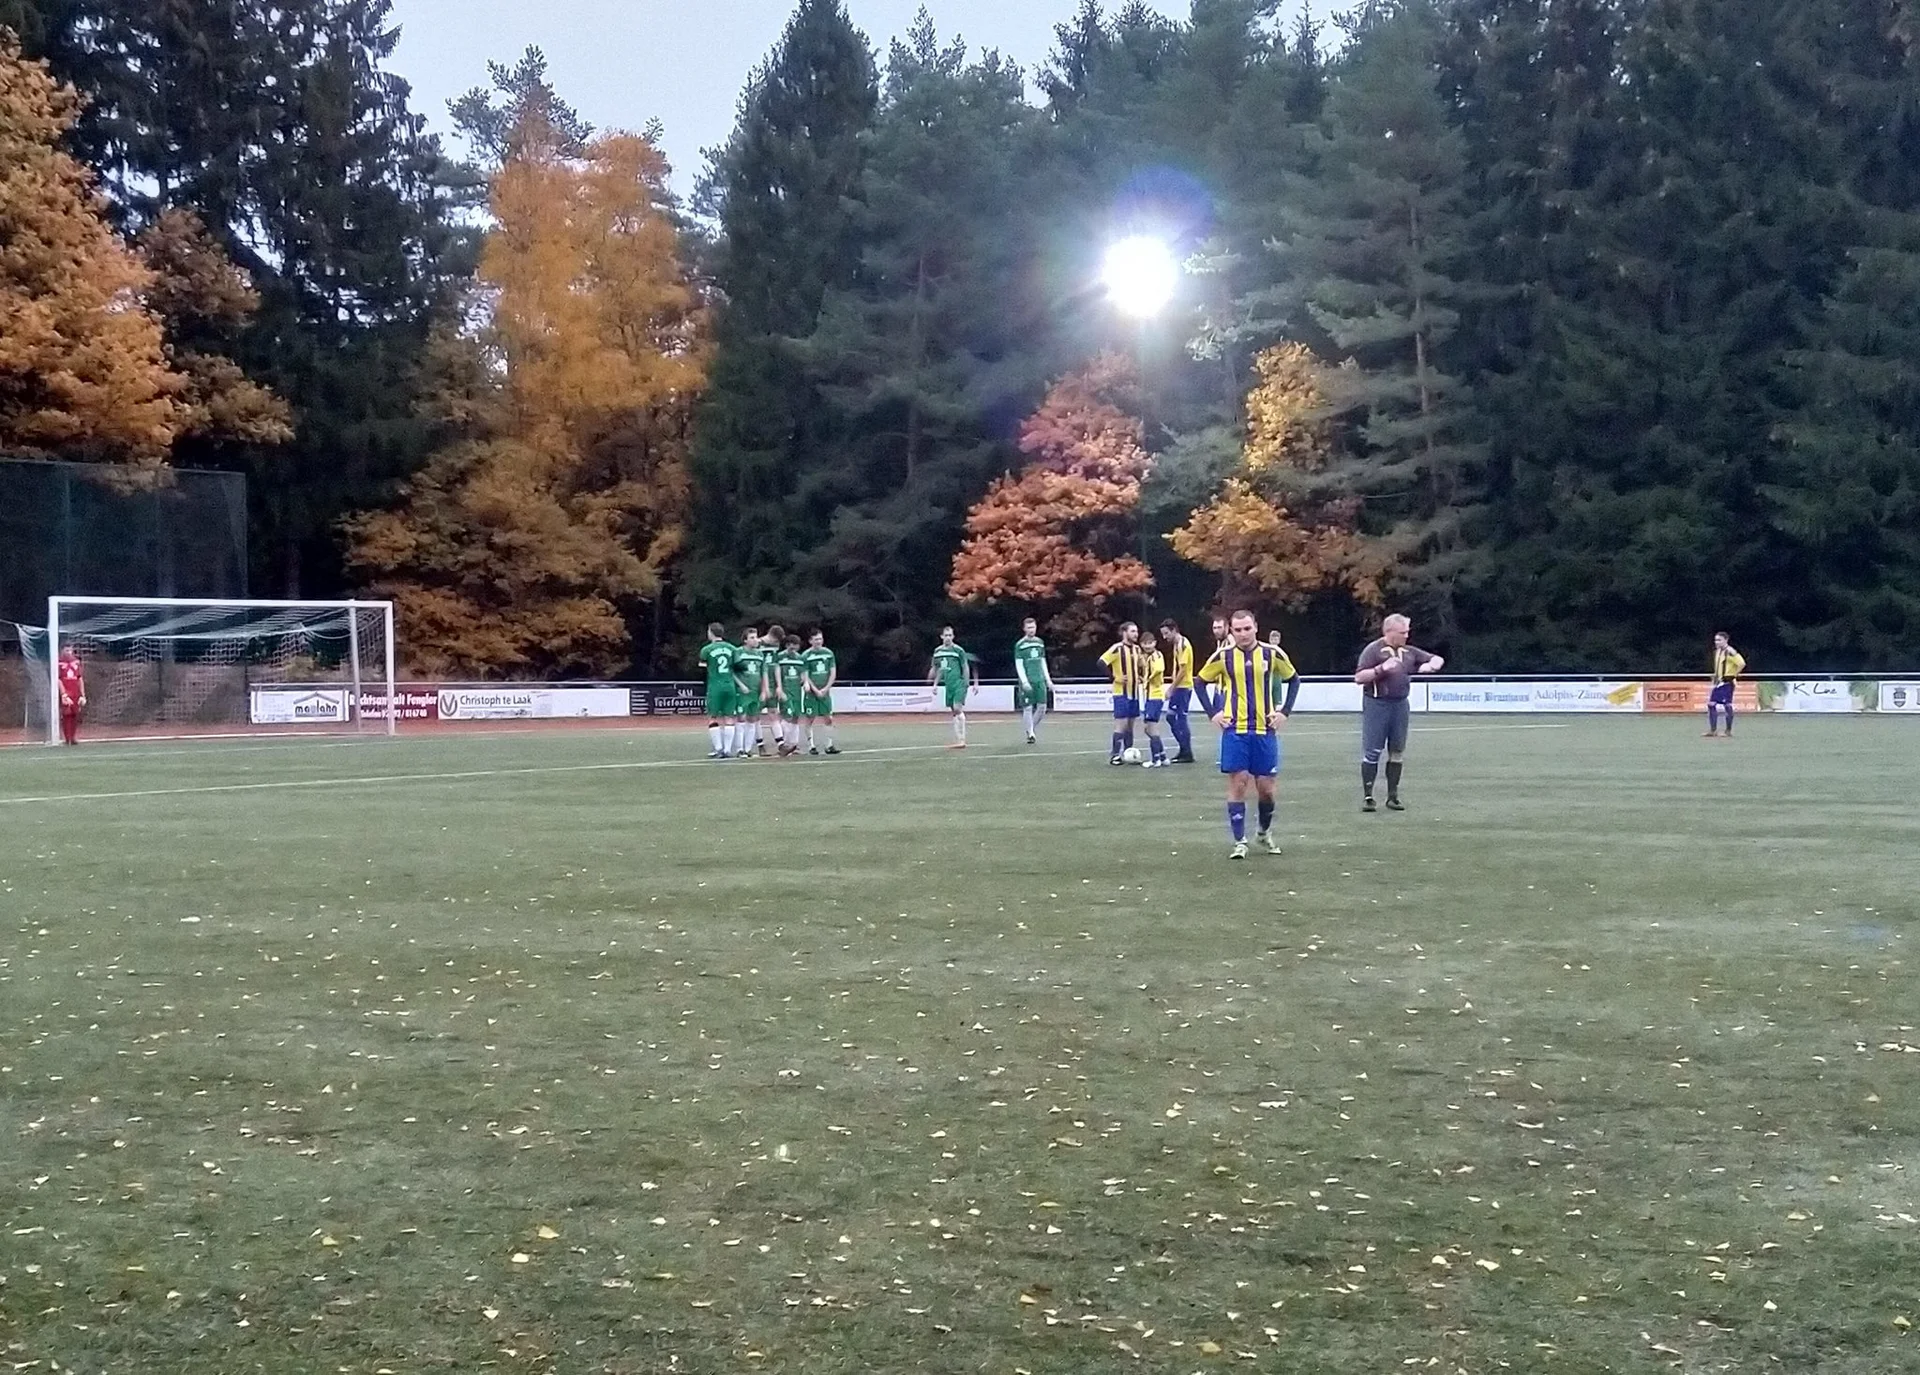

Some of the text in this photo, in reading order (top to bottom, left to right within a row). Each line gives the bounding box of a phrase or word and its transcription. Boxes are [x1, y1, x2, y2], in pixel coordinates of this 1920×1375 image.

[717, 656, 729, 673] 2
[349, 693, 405, 706] Rchtsanalt
[460, 695, 532, 707] Christoph te Laak
